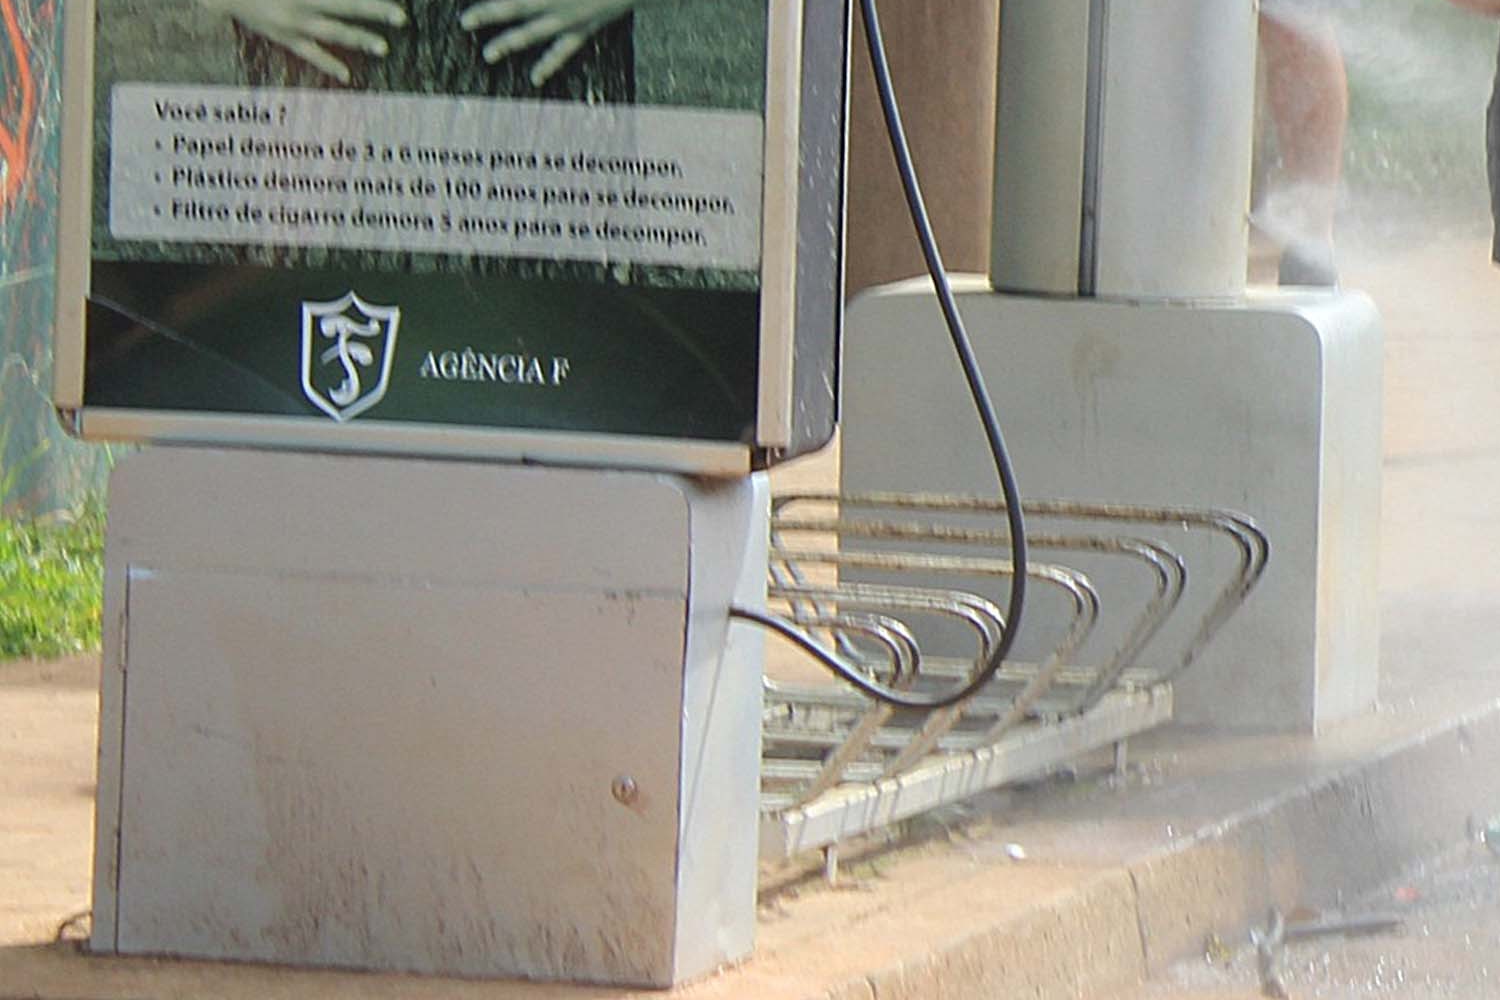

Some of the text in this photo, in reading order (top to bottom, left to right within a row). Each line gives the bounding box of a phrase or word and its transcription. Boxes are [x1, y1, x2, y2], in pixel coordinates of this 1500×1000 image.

[173, 133, 234, 159] Papel
[240, 137, 324, 161] demora
[332, 138, 357, 162] de
[382, 145, 393, 162] a
[418, 148, 483, 167] meses
[490, 152, 538, 171] para
[544, 156, 566, 170] se
[419, 346, 571, 386] AGÊNCIA F
